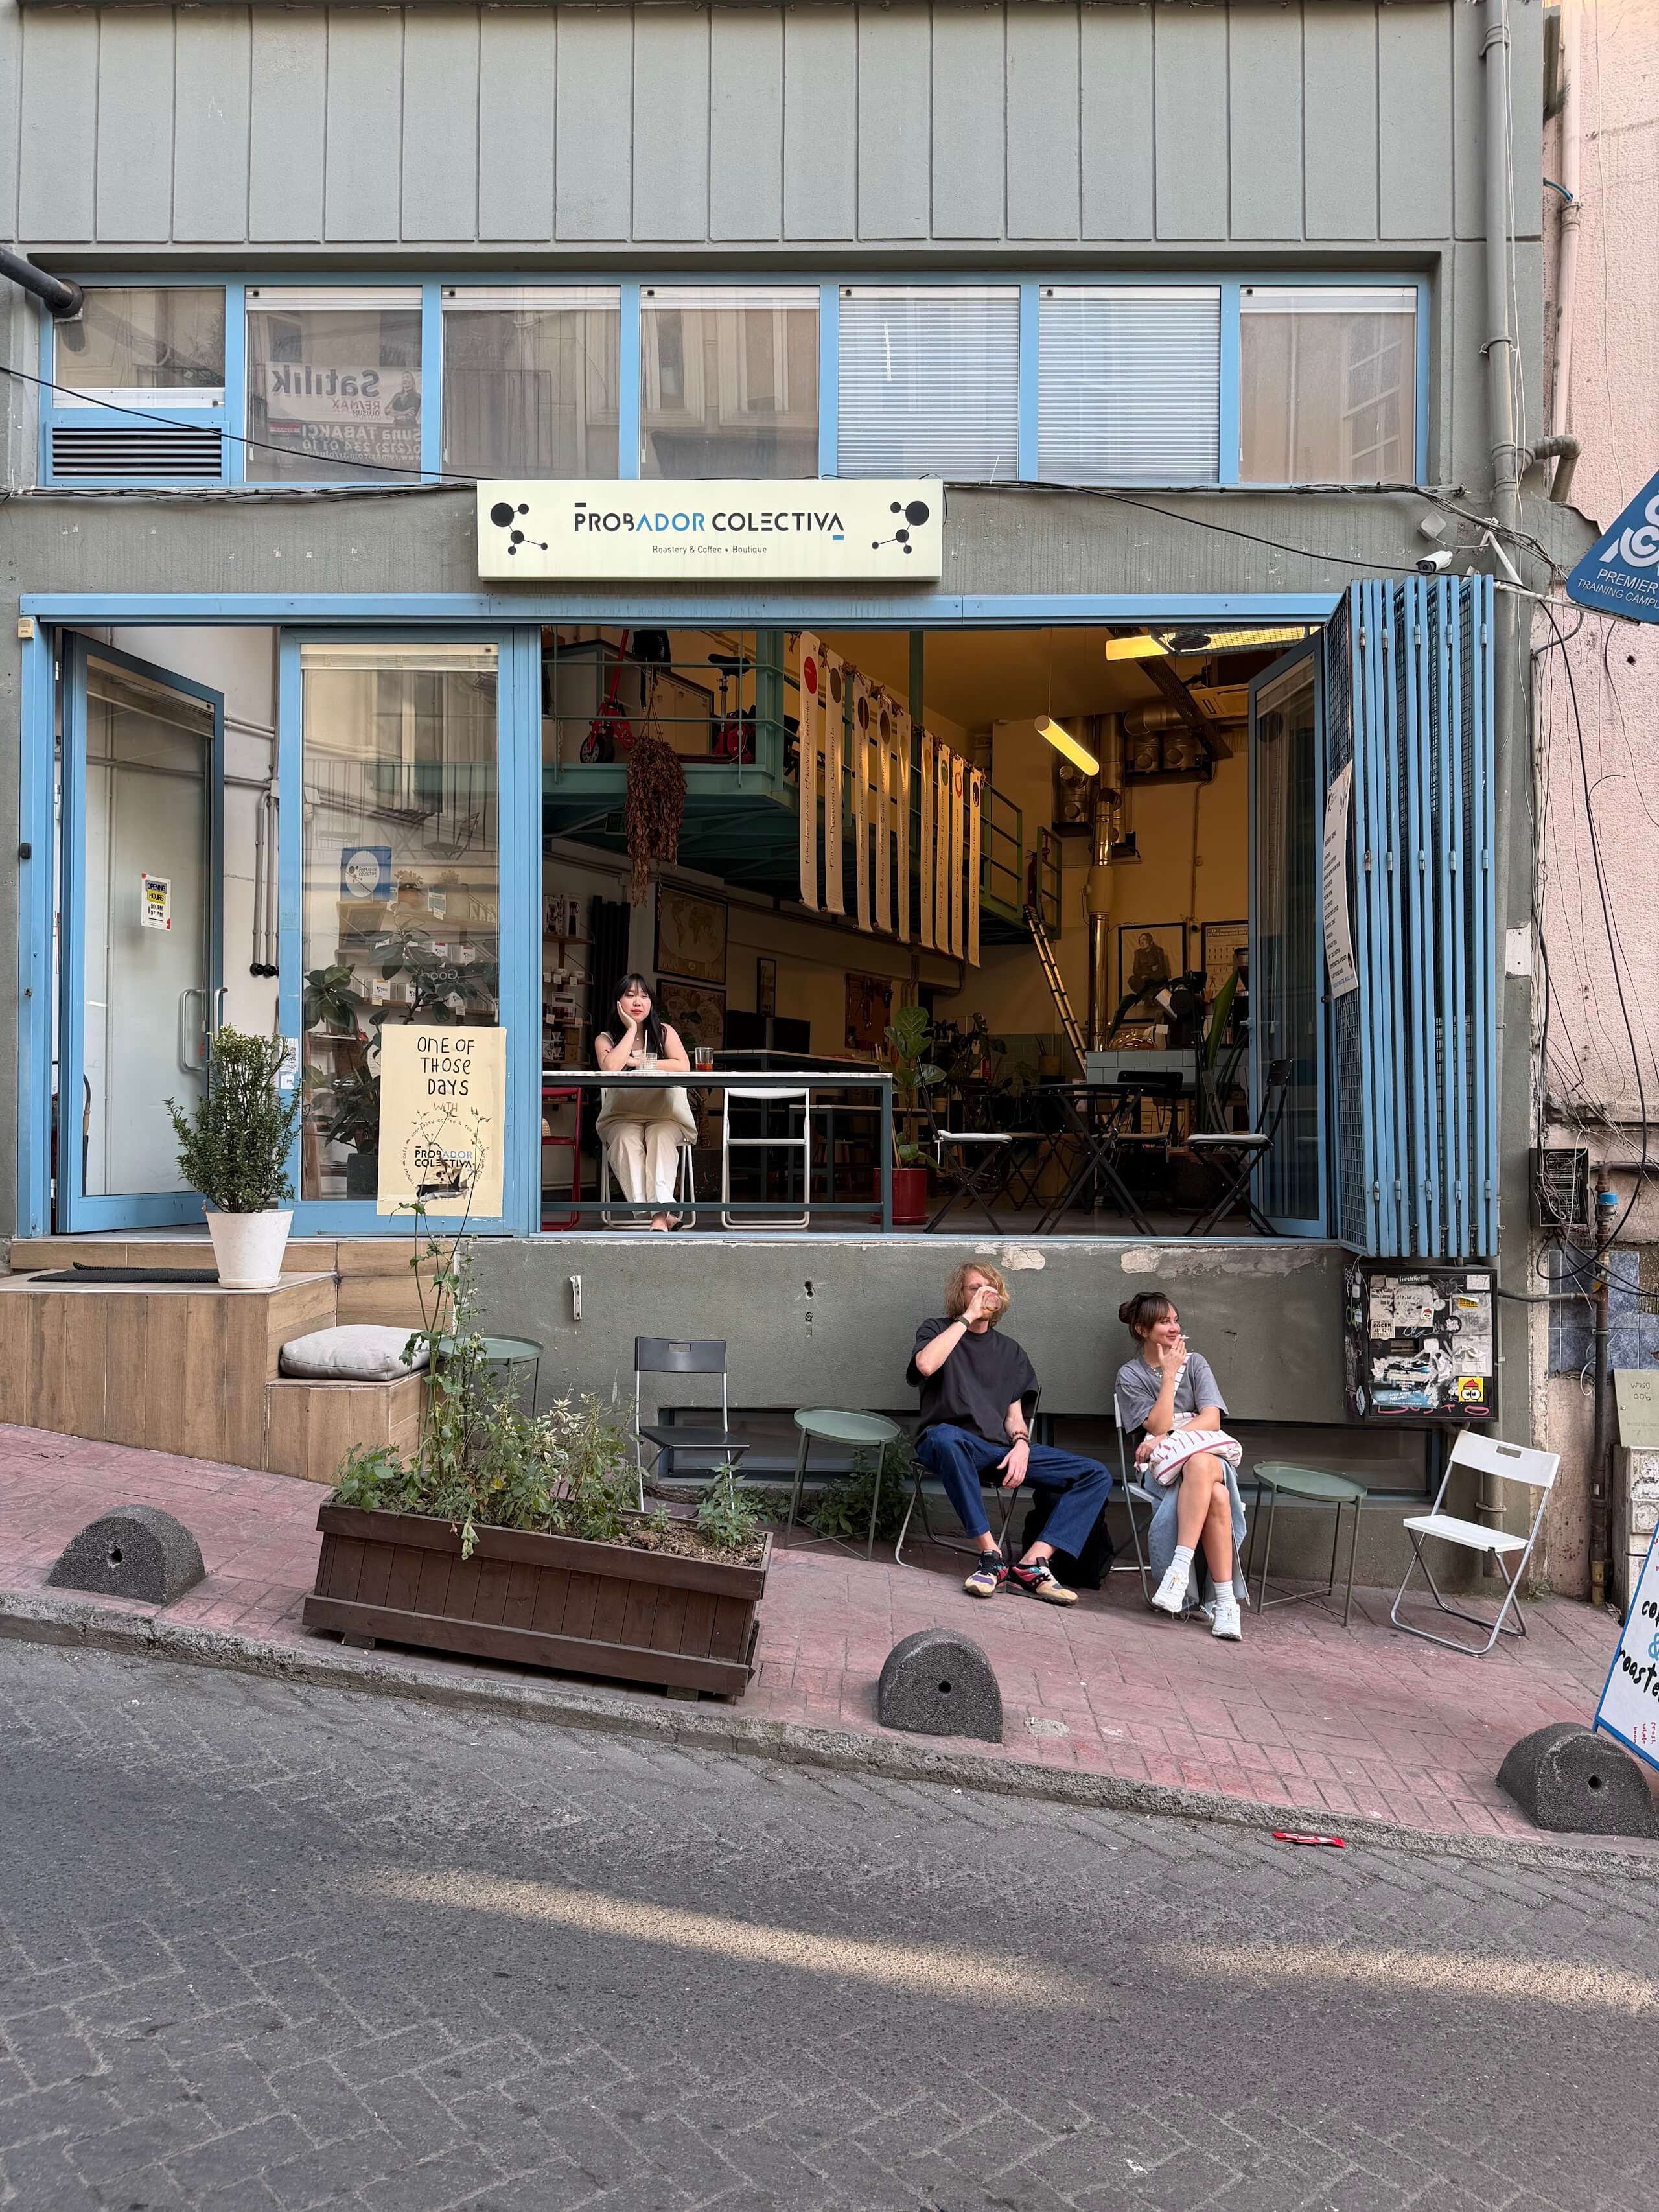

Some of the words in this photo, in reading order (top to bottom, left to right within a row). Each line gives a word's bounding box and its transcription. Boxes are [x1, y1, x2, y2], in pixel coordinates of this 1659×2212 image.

[574, 511, 706, 531] PROBADOR
[712, 511, 845, 531] COLECTIVA
[652, 544, 688, 555] Roastery
[689, 545, 696, 553] &
[697, 544, 723, 554] Coffee
[732, 544, 767, 555] Boutique
[1577, 577, 1624, 599] TRAINING
[1597, 568, 1659, 594] PREMIER
[147, 882, 166, 892] OPENING
[149, 892, 165, 902] HOURS
[456, 1038, 475, 1055] OF
